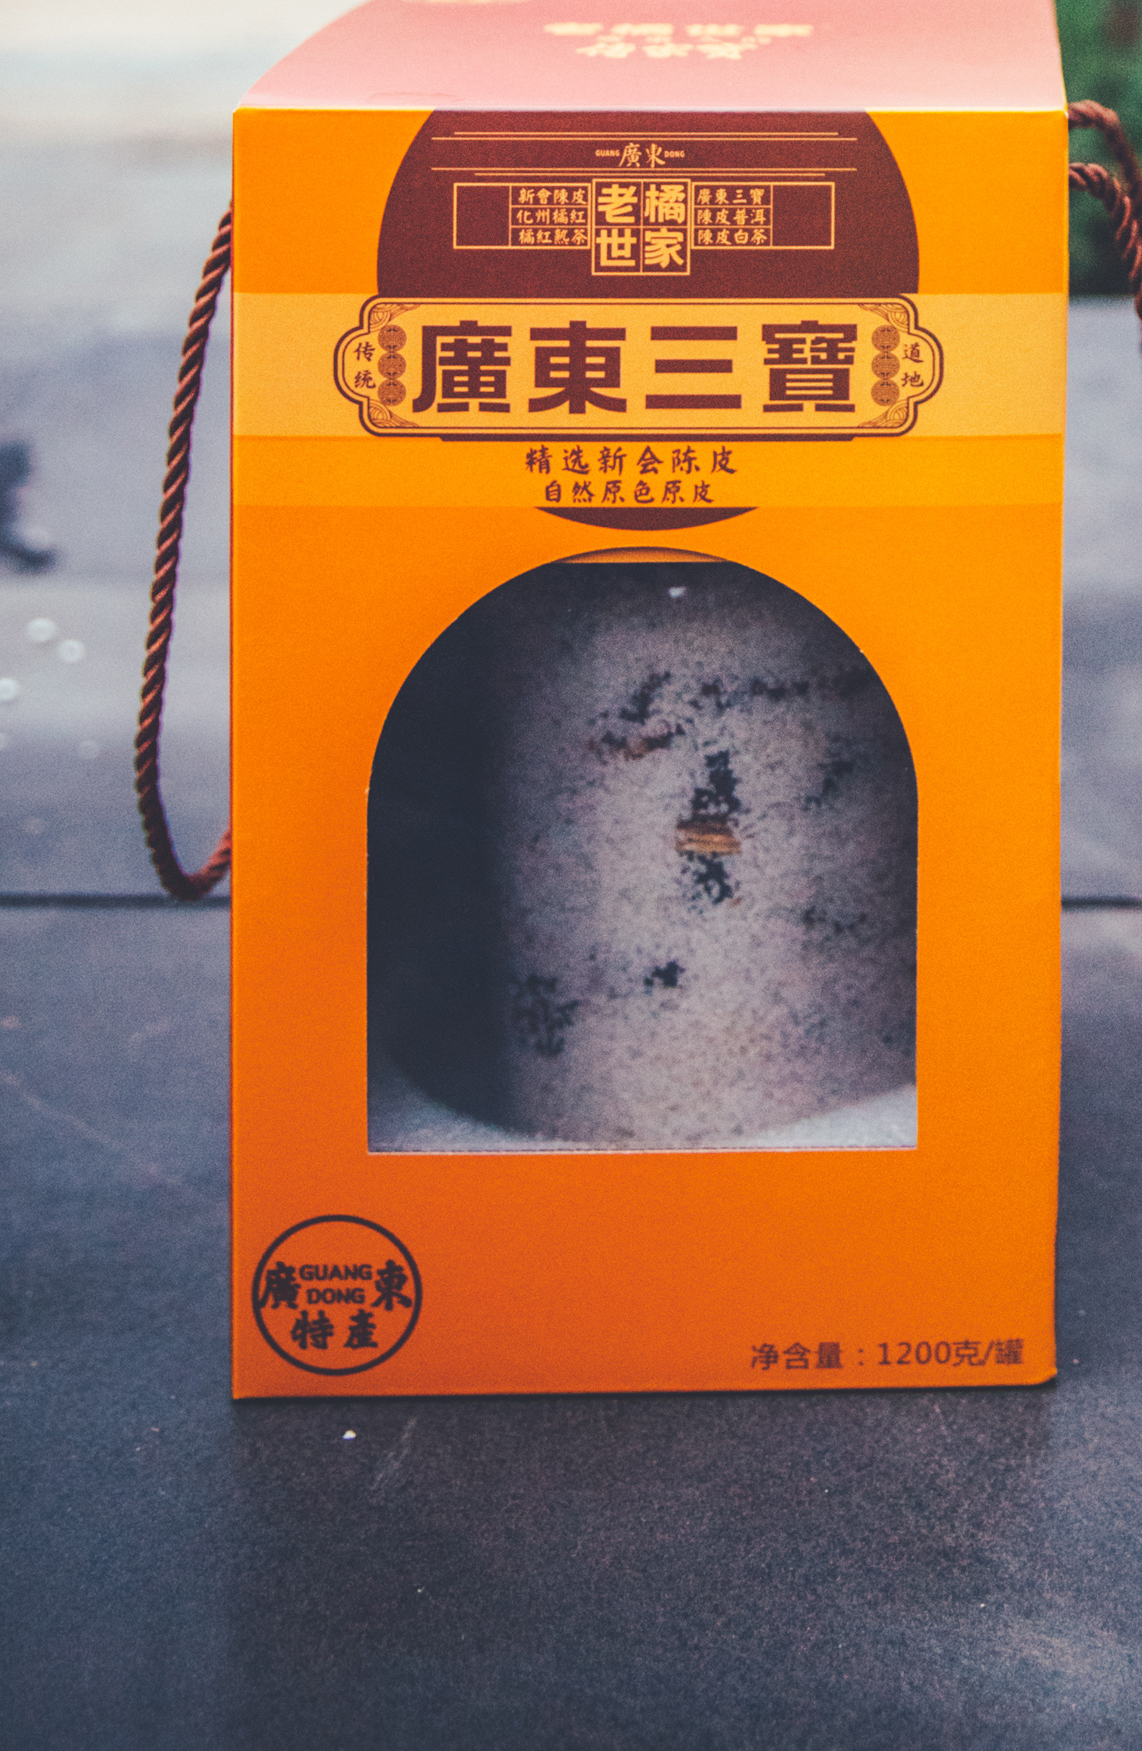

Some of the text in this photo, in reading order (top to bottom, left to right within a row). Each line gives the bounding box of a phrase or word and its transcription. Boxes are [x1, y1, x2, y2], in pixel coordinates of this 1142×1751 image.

[595, 142, 685, 168] GUANG 廣東 DONG
[518, 187, 588, 205] 新會陳皮
[516, 208, 587, 225] 化州橘紅
[697, 208, 767, 225] 陳皮普洱
[698, 228, 768, 246] 陳皮白茶
[354, 341, 376, 389] 传统
[412, 320, 858, 414] 廣東三寶
[901, 342, 924, 387] 道地
[525, 444, 738, 476] 精选新会陈皮
[545, 479, 714, 504] 自然原色原皮
[299, 1264, 373, 1281] GUANG
[306, 1287, 366, 1305] DONG
